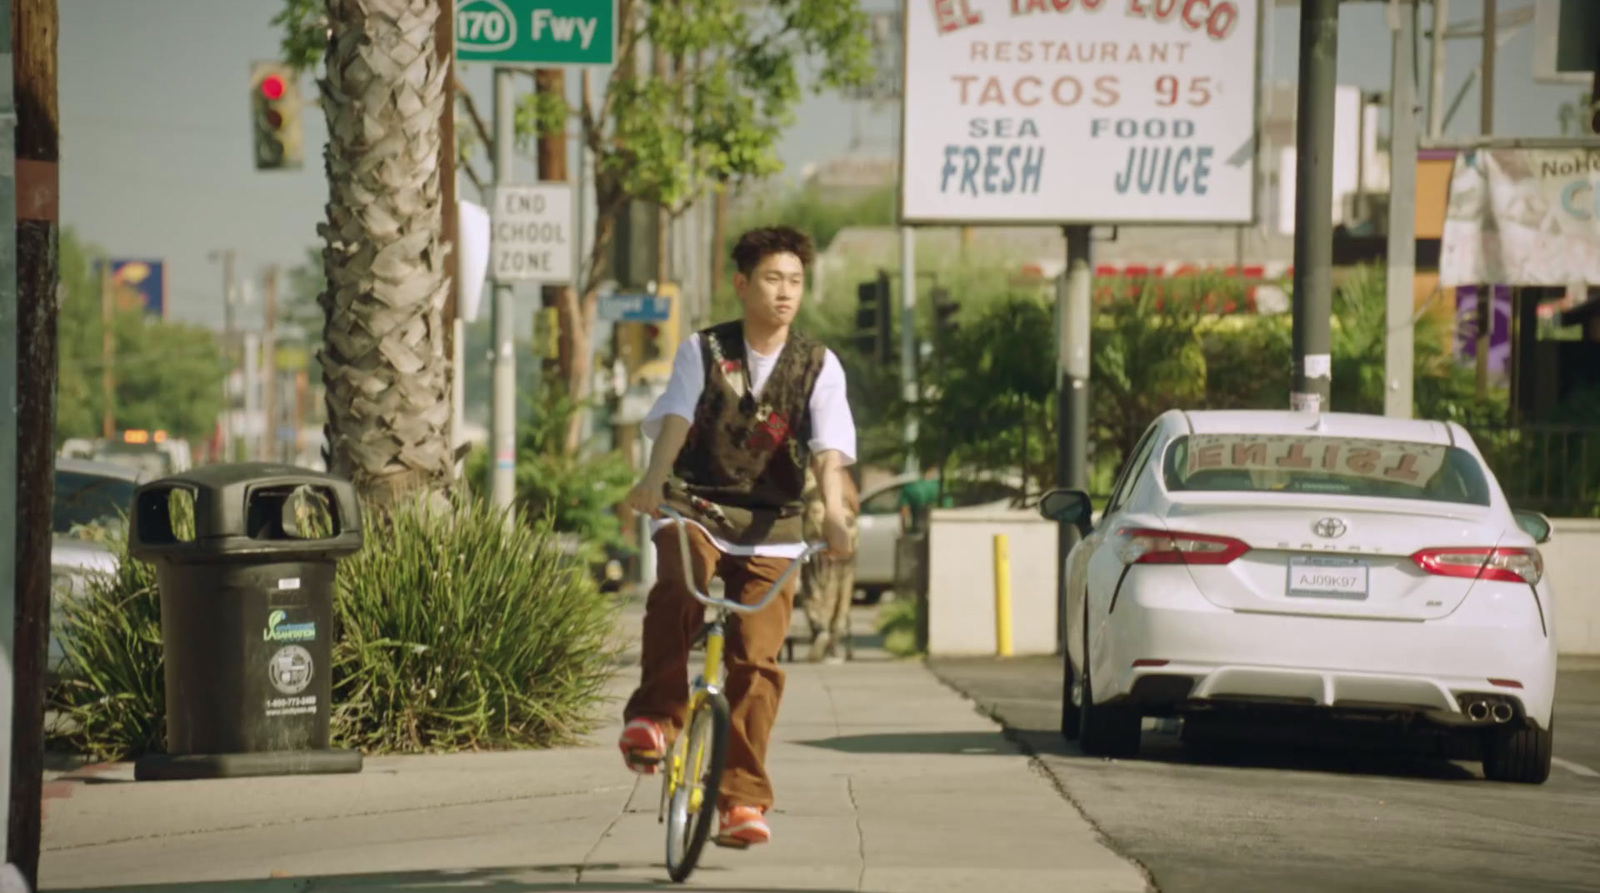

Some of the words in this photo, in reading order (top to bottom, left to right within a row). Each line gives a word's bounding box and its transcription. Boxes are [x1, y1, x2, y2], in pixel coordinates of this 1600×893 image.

[459, 11, 506, 41] 170
[531, 8, 598, 50] Fwy
[969, 41, 1192, 63] RESTAURANT
[952, 75, 1121, 107] TACOS
[968, 118, 1040, 139] SEA
[1091, 118, 1196, 139] FOOD
[940, 145, 1045, 196] FRESH
[1115, 146, 1215, 196] JUICE
[506, 193, 547, 215] END
[500, 250, 552, 273] ZONE
[1300, 574, 1357, 588] AJ09K97
